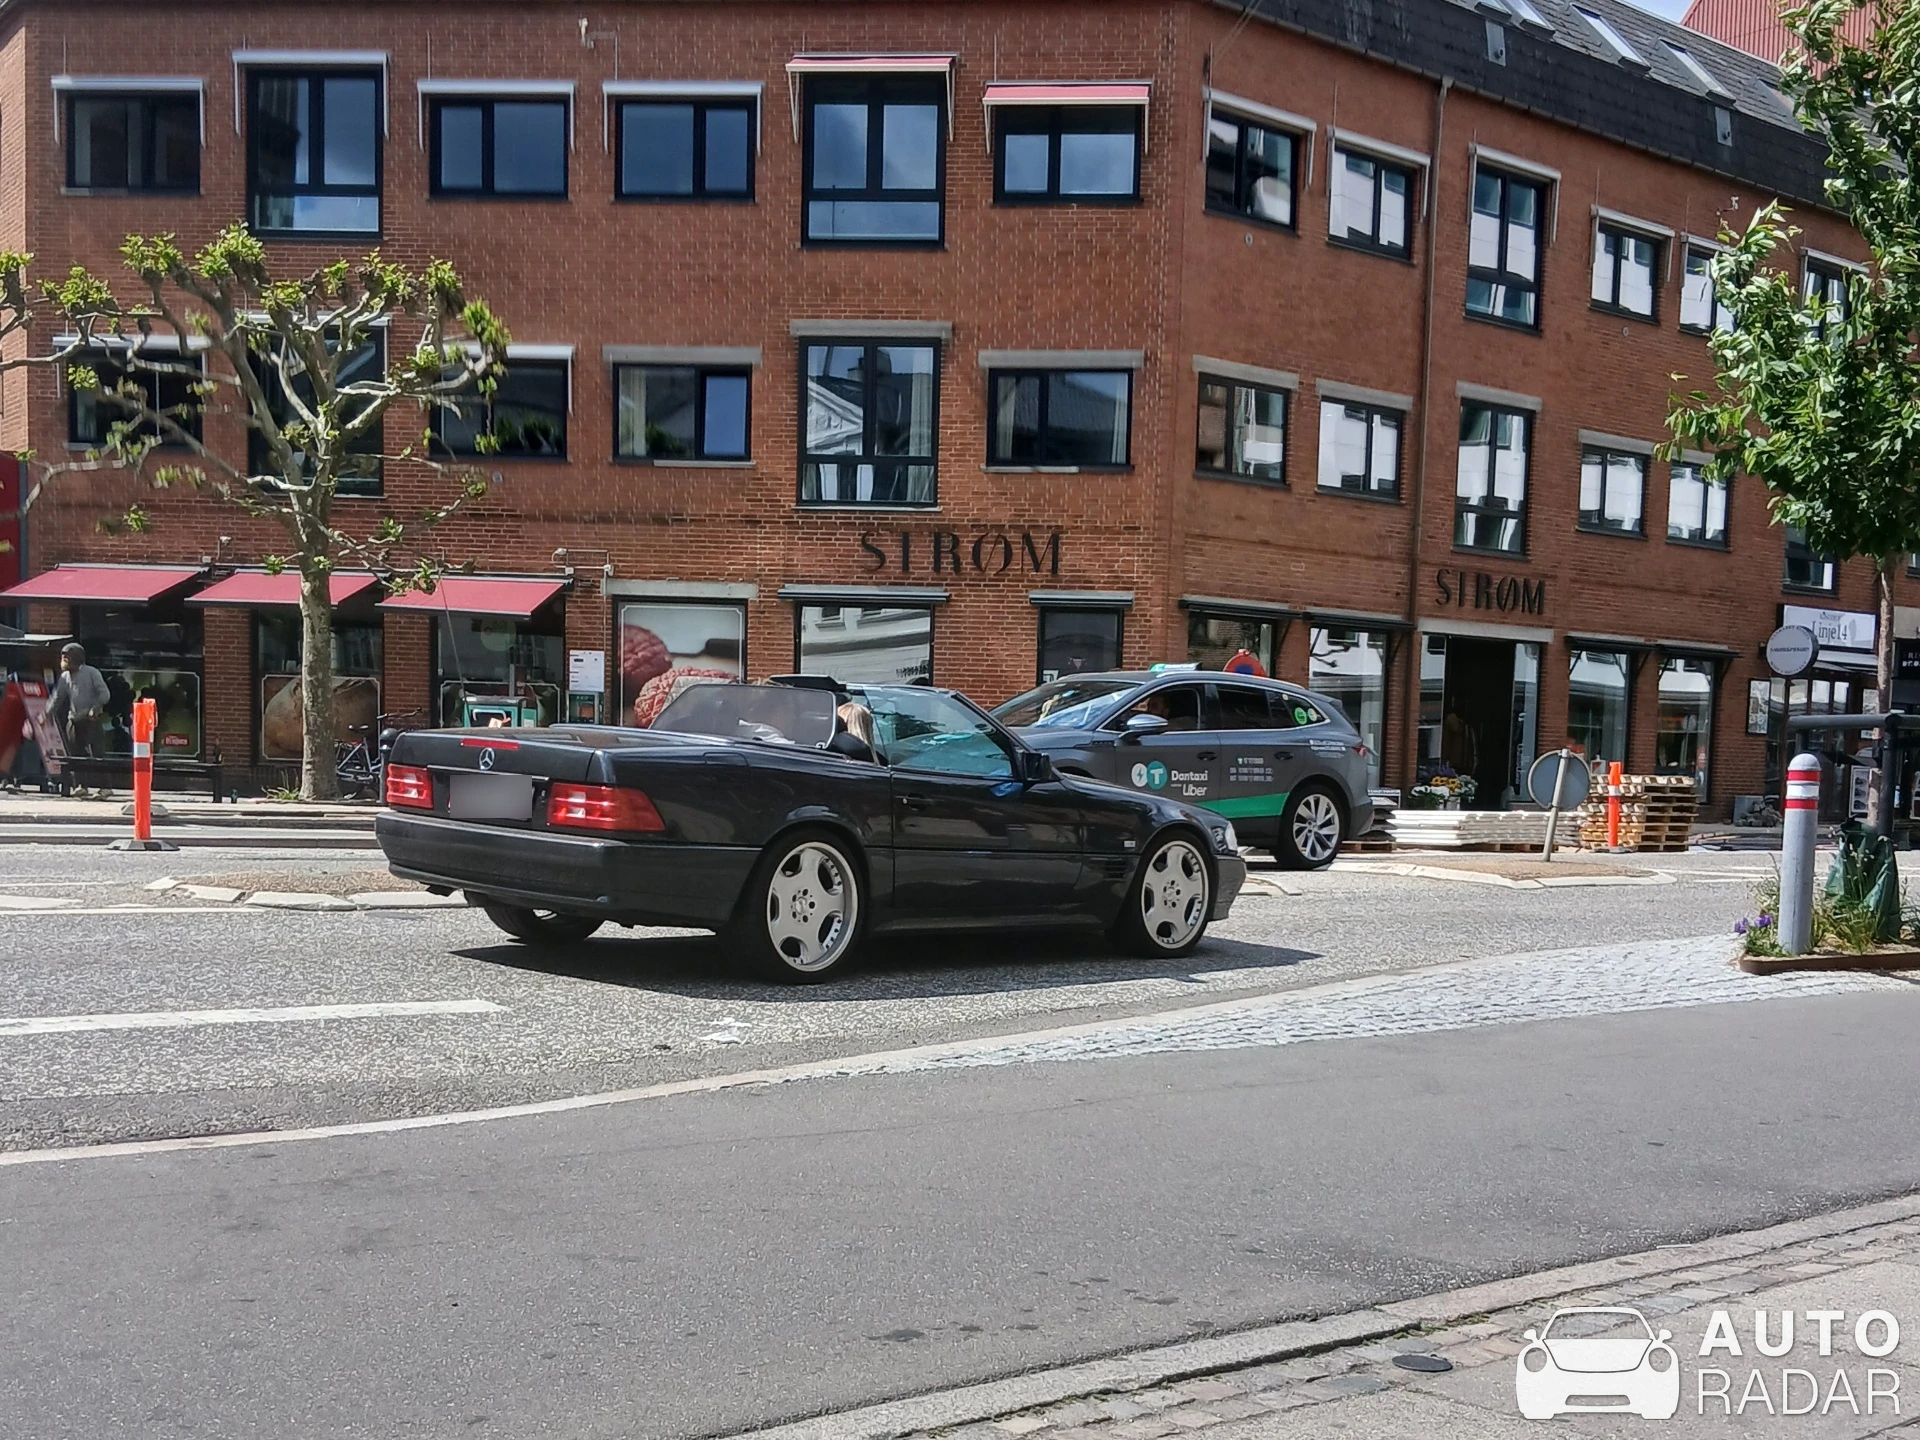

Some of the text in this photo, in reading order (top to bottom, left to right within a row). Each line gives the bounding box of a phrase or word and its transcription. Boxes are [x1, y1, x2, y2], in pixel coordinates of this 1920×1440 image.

[861, 530, 1062, 576] STRØM
[1435, 568, 1546, 615] STRØM
[1171, 770, 1209, 781] Dantaxi
[1182, 783, 1208, 796] Uber
